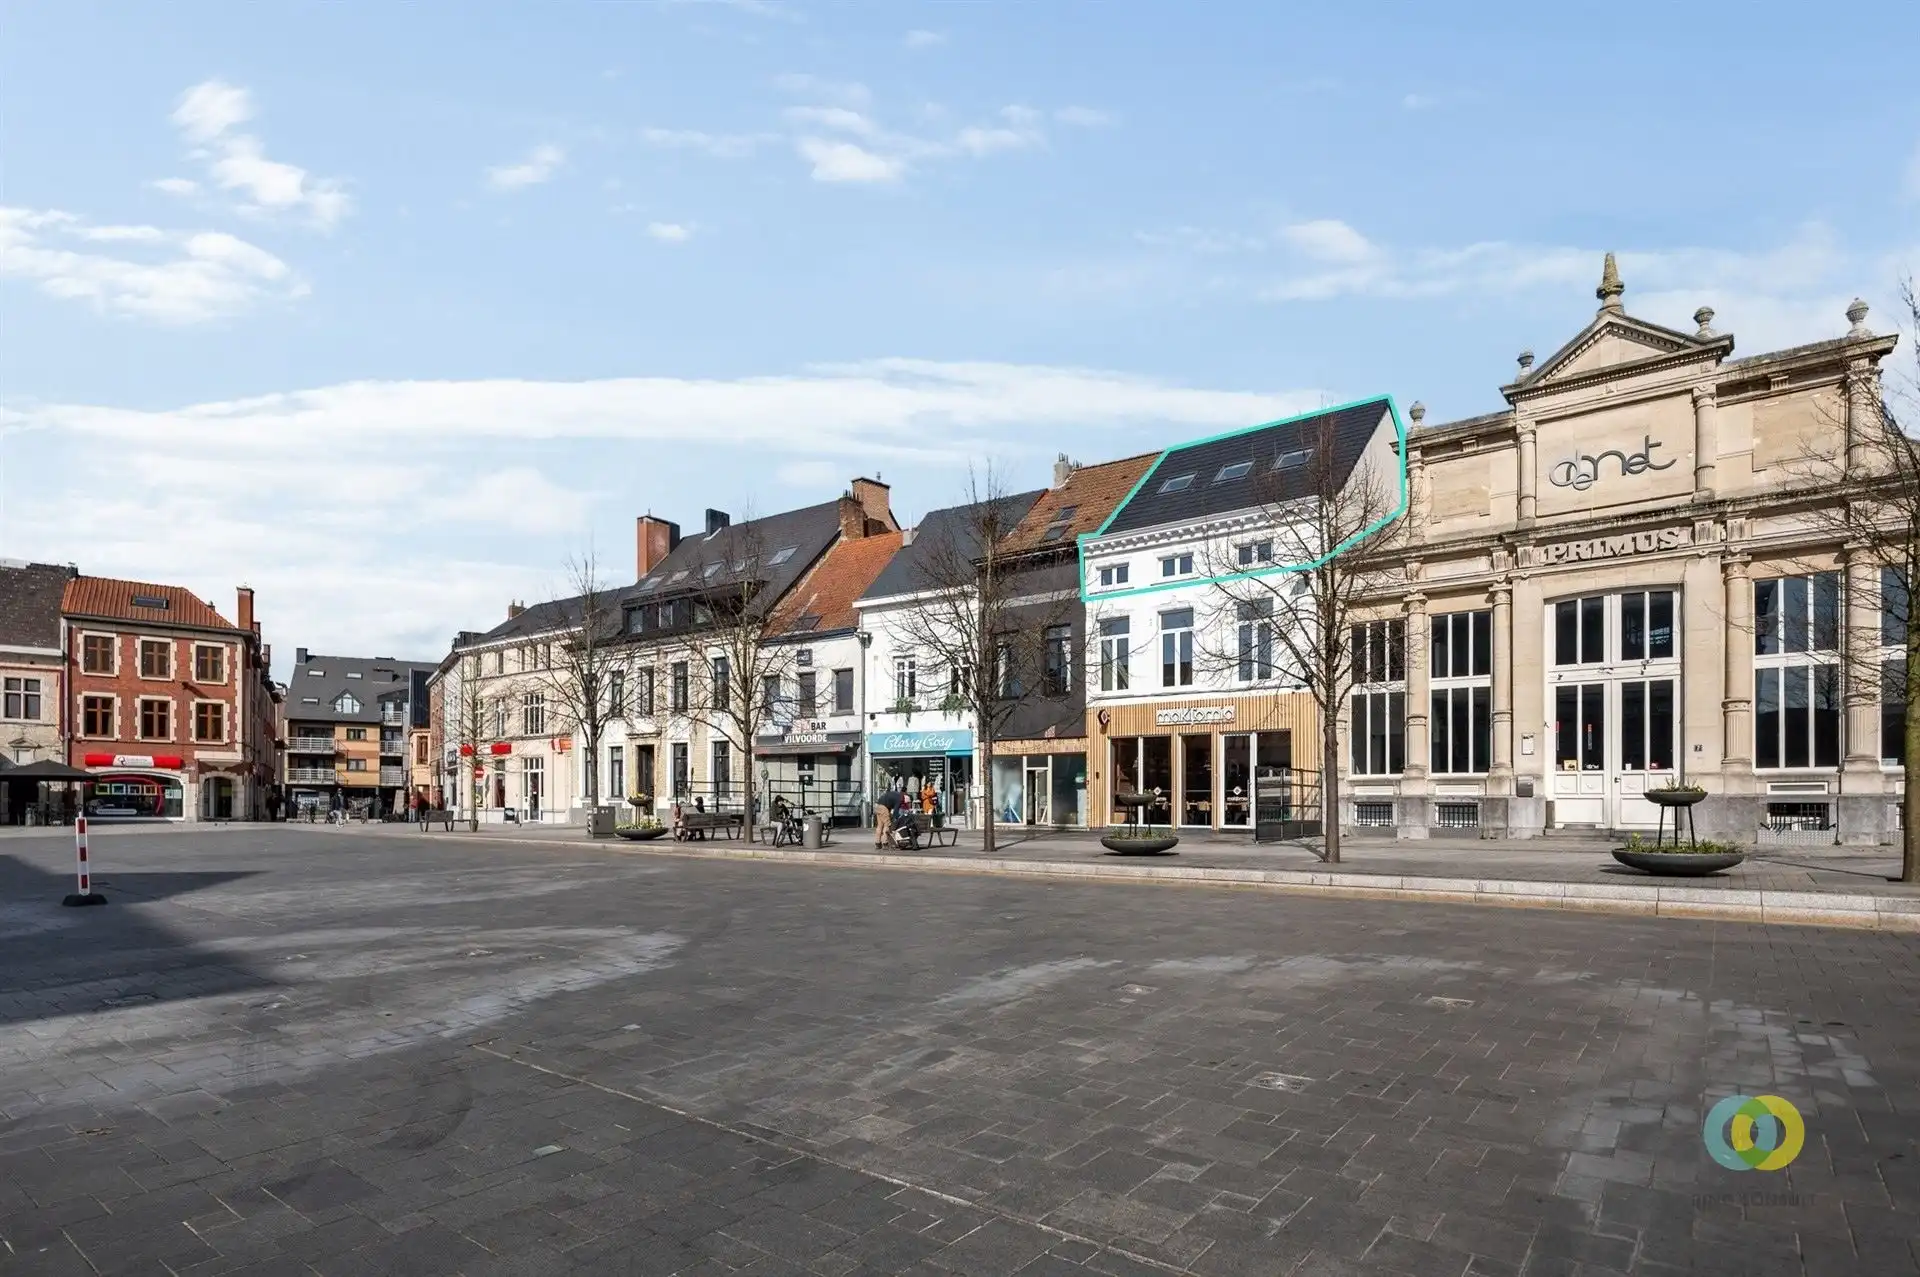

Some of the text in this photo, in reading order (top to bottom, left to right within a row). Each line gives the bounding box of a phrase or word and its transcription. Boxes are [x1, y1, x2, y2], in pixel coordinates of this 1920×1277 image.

[1544, 527, 1679, 565] PRIMUS
[811, 721, 827, 731] BAR
[784, 733, 828, 744] VILVOORDE
[883, 733, 954, 750] Classy Cosy
